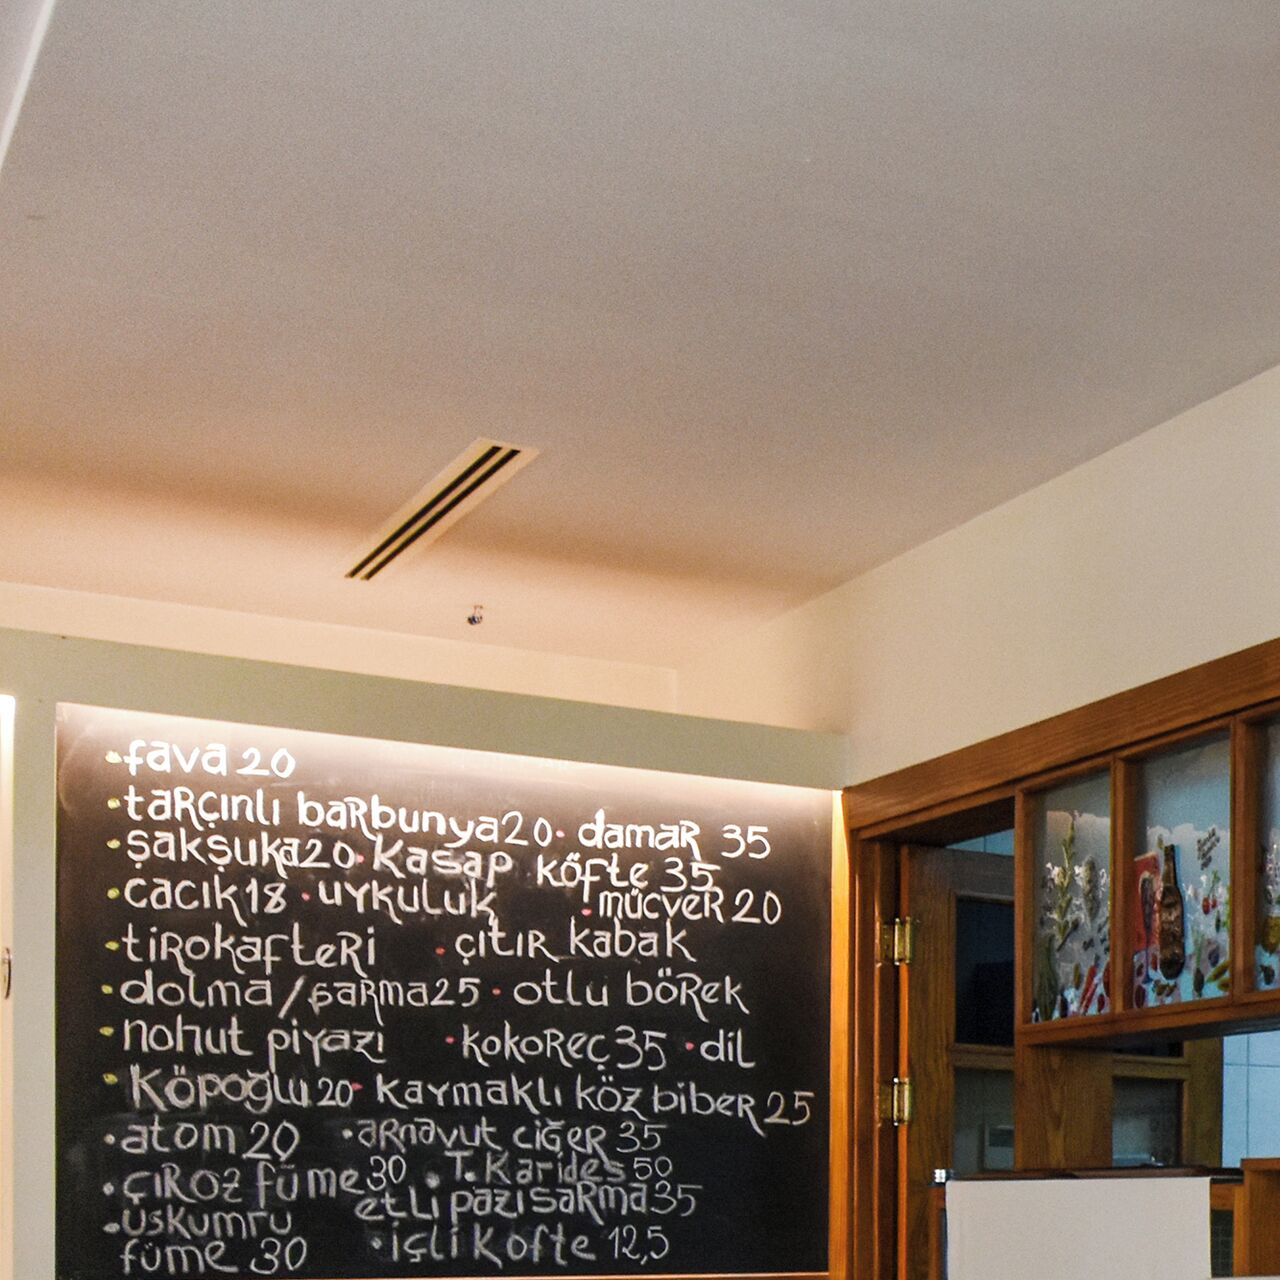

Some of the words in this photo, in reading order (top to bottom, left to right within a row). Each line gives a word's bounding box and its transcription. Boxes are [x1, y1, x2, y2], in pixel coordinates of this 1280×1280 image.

[123, 738, 228, 777] fava
[236, 748, 297, 779] 20
[721, 824, 772, 860] 35
[660, 857, 722, 893] 35
[123, 1014, 254, 1057] nohut
[614, 1024, 668, 1072] 35
[700, 1027, 756, 1069] dil
[120, 1113, 237, 1155] atom
[242, 1120, 300, 1162] 20
[615, 1120, 669, 1153] 35
[632, 1156, 673, 1181] 50
[250, 1236, 308, 1275] 30
